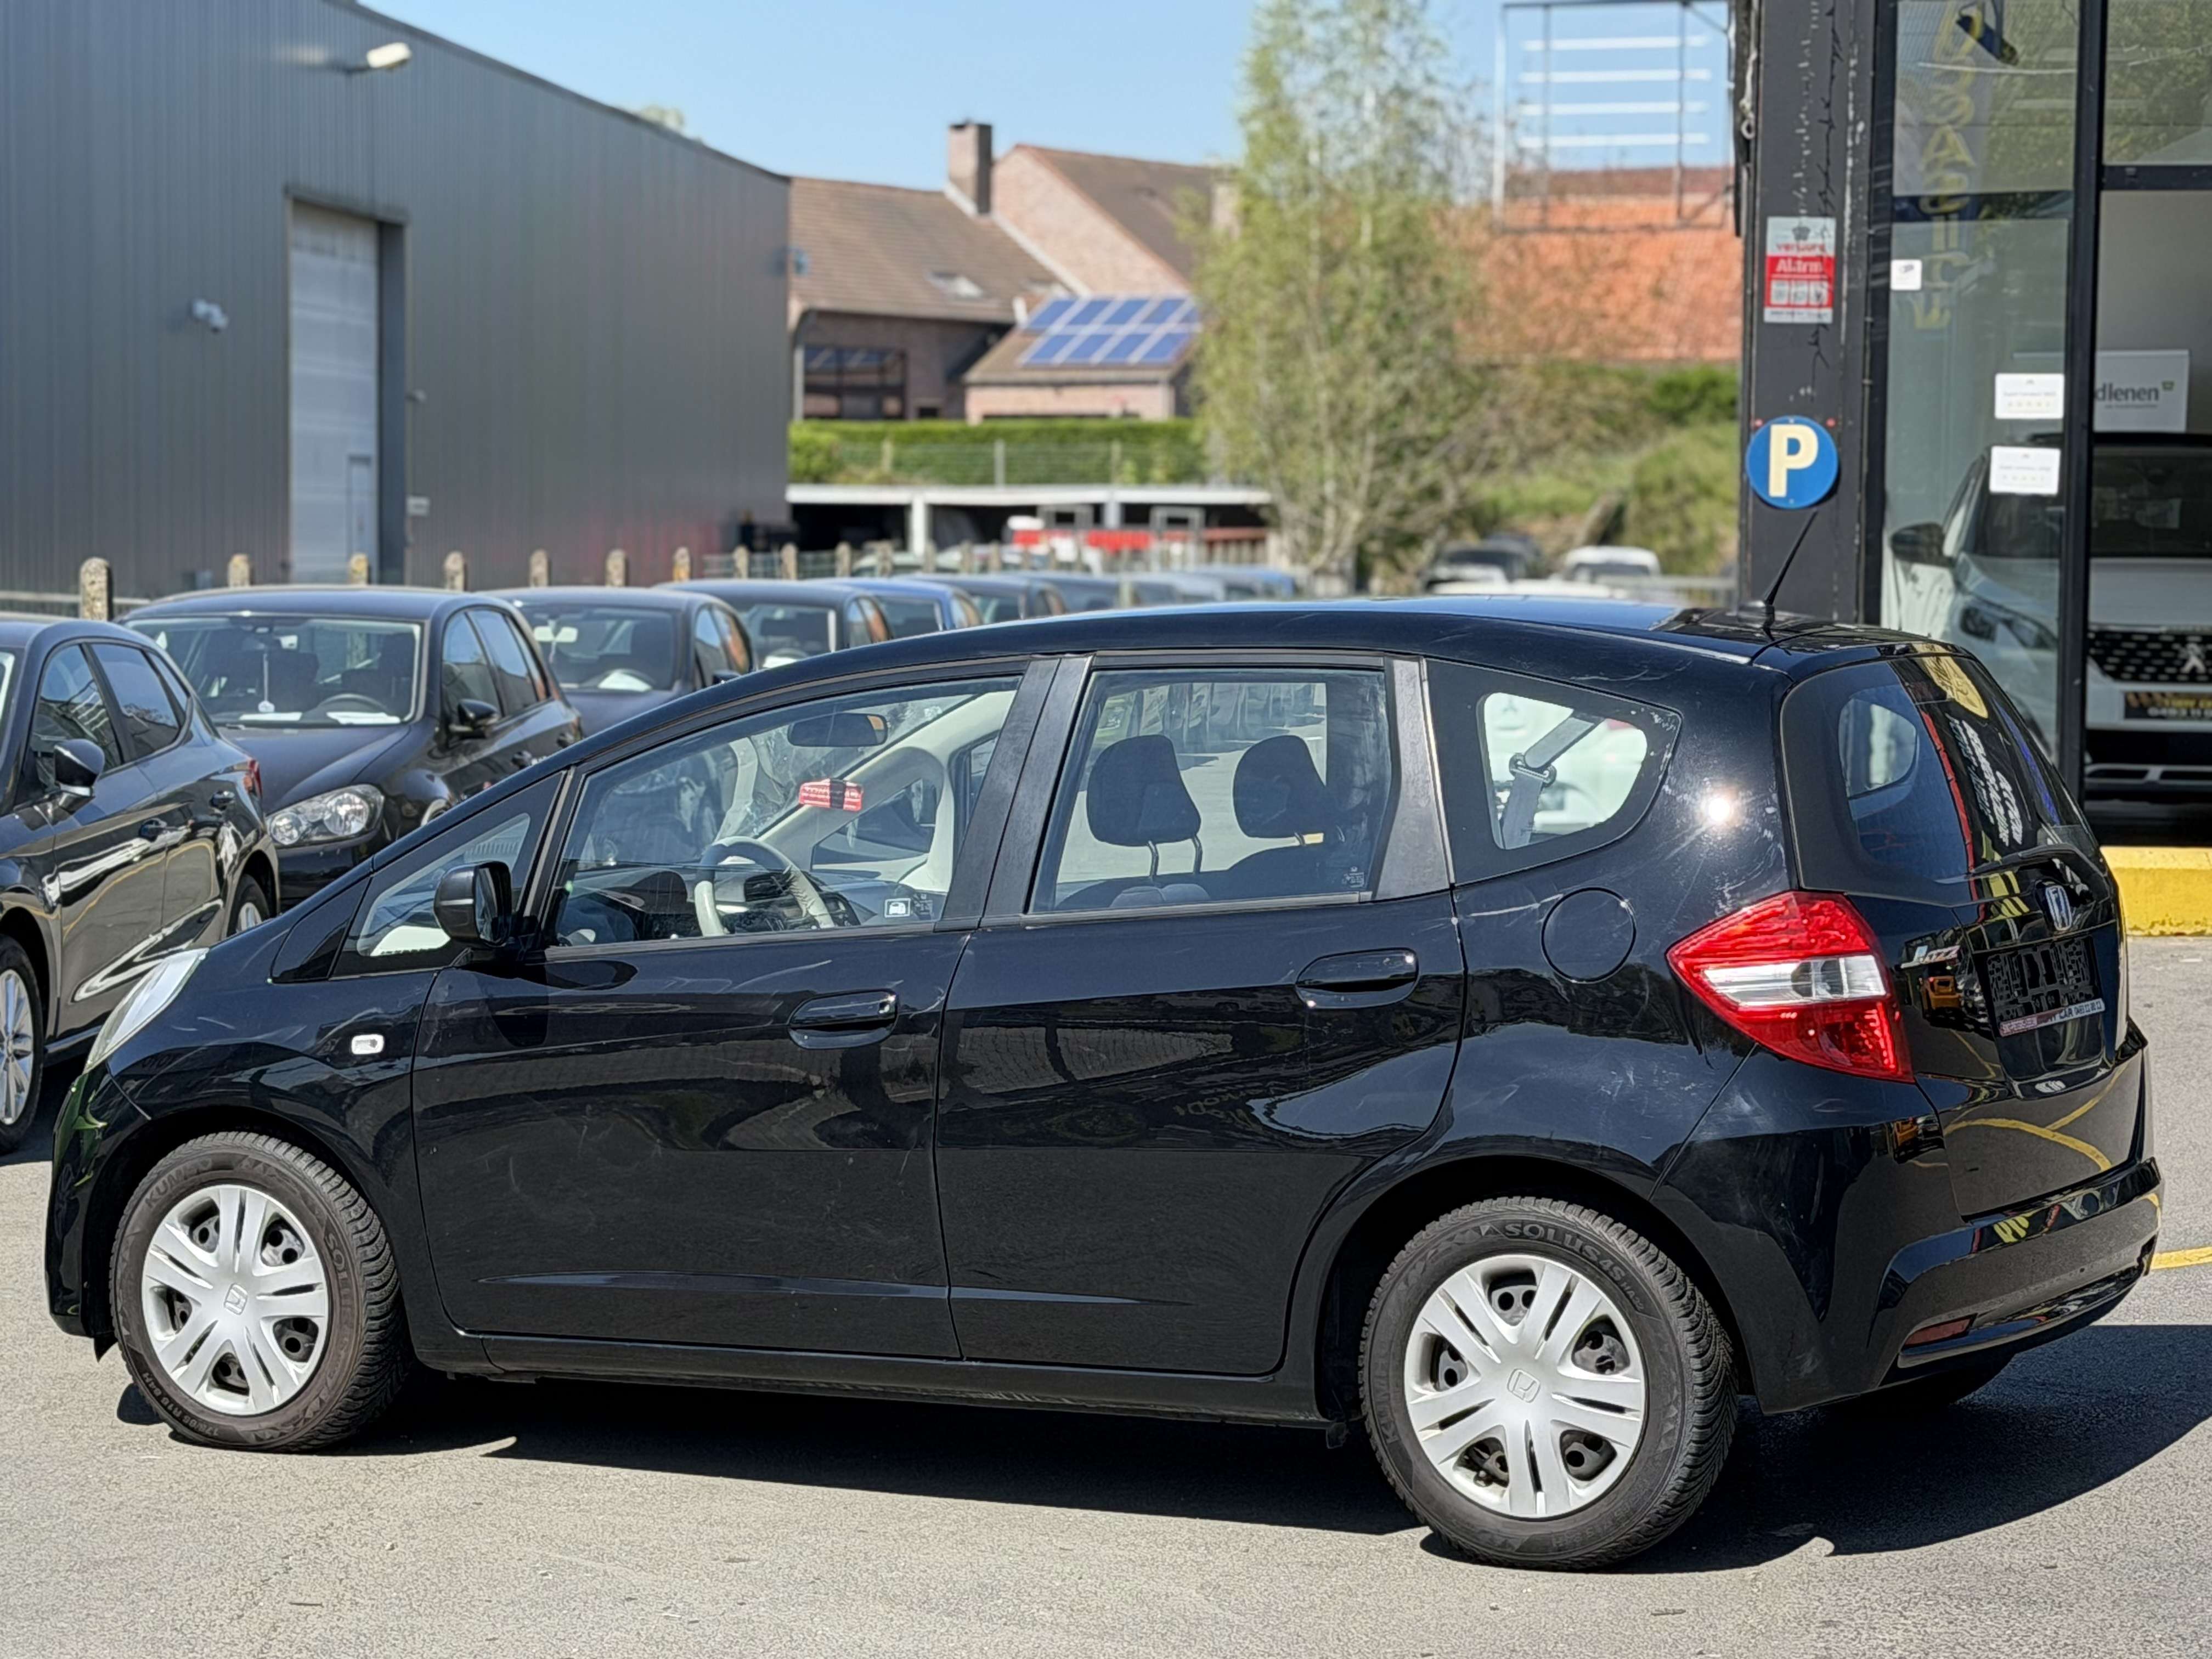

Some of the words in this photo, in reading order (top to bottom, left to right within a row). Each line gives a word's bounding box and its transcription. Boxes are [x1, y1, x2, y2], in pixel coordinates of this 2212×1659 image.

[1769, 424, 1818, 498] P
[1505, 1223, 1601, 1262] SOLUS
[1599, 1259, 1627, 1282] 4S
